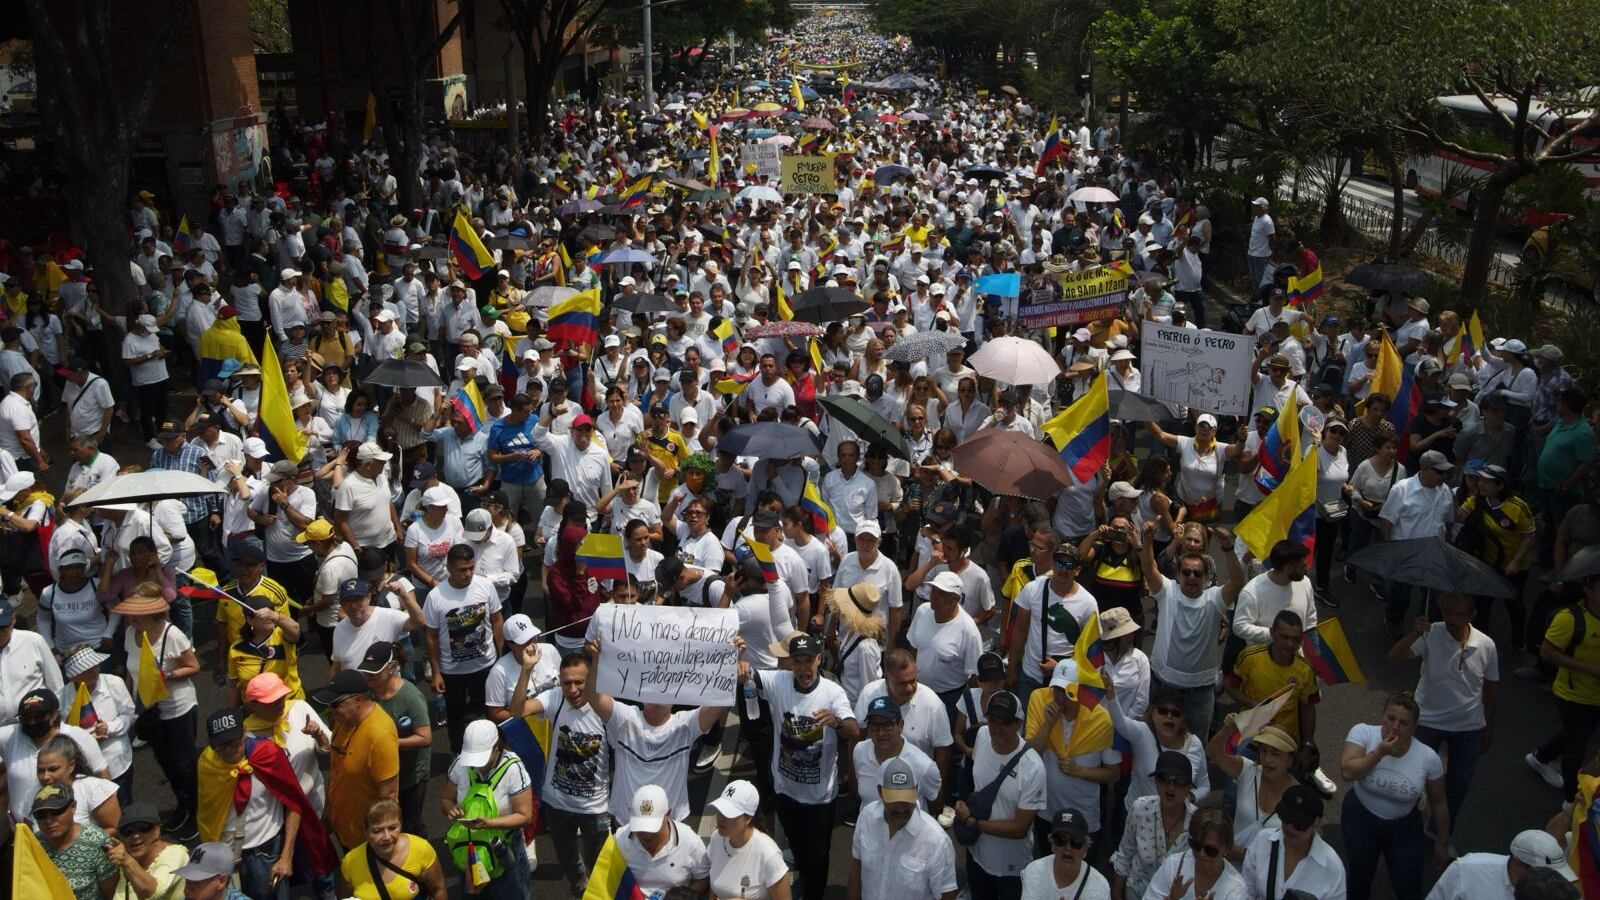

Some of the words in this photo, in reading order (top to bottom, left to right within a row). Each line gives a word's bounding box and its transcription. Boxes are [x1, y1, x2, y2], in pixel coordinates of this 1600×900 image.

[792, 172, 820, 184] PETRO
[1066, 287, 1076, 298] de
[1157, 329, 1190, 345] PATRIA
[1205, 337, 1235, 350] PETRO
[650, 622, 680, 641] mas
[617, 650, 637, 663] en
[212, 714, 236, 731] DIOS
[1364, 775, 1418, 797] GUESS
